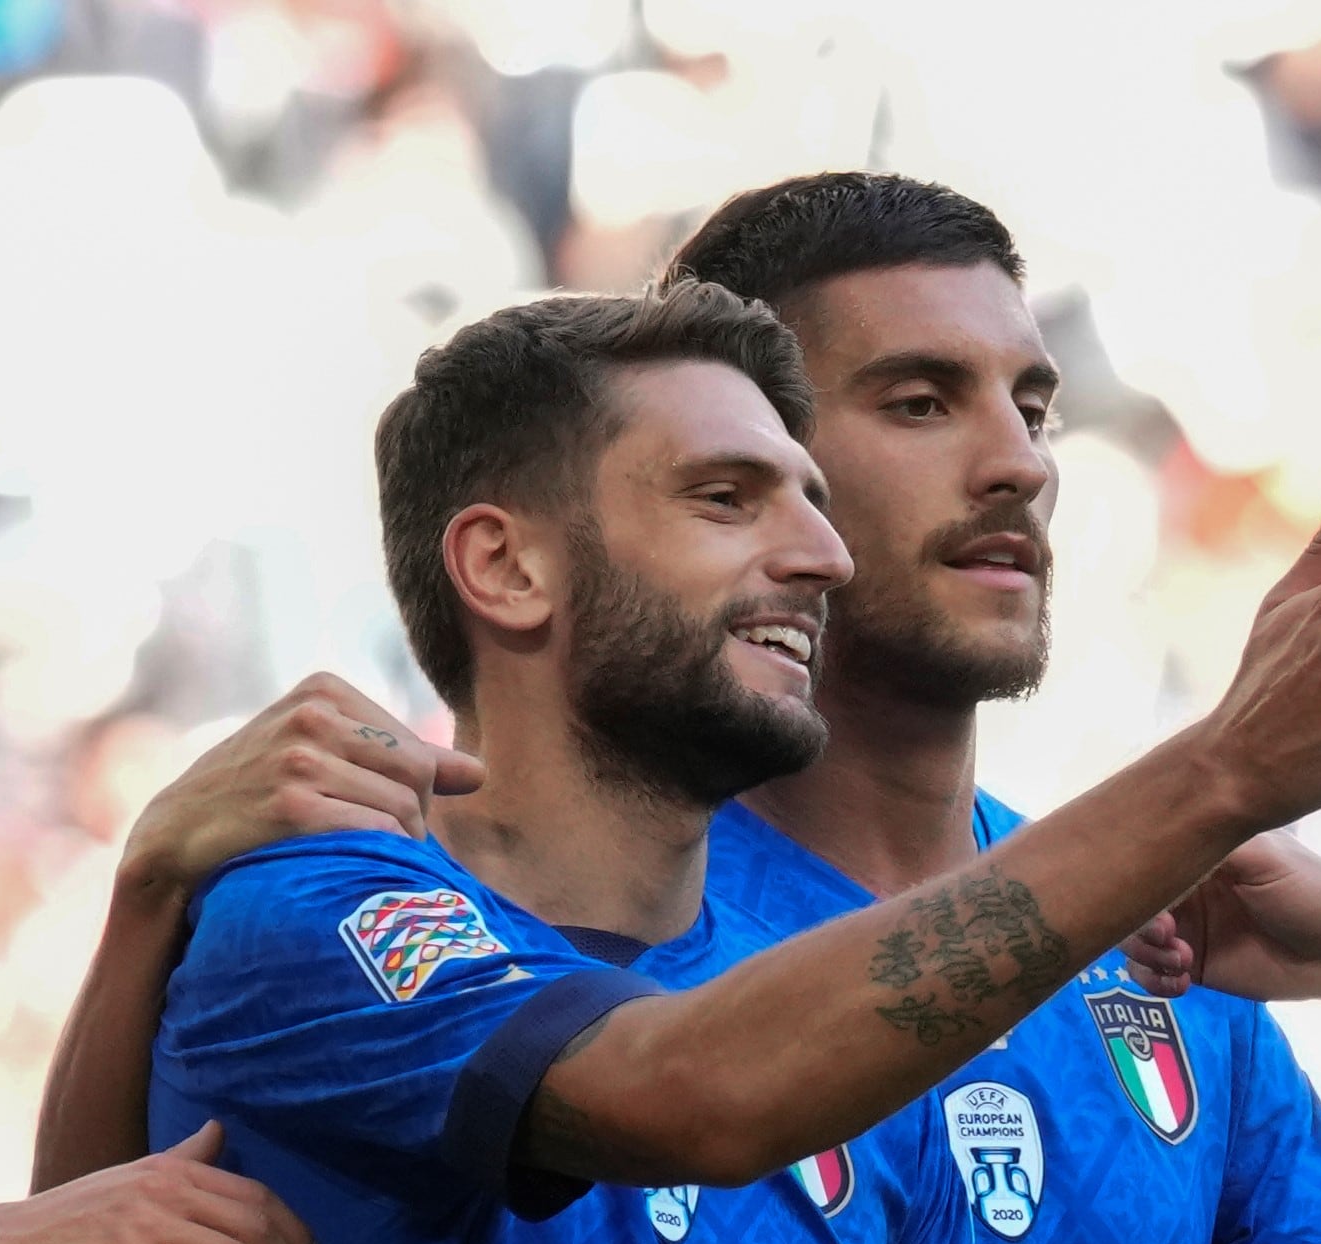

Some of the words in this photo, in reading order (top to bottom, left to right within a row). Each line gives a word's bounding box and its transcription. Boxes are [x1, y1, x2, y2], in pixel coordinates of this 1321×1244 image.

[1094, 1003, 1166, 1029] ITALIA
[968, 1090, 1005, 1107] UEFA
[957, 1113, 1023, 1125] EUROPEAN
[960, 1127, 1025, 1137] CHAMPIONS
[655, 1209, 681, 1227] 2020
[992, 1208, 1023, 1221] 2020
